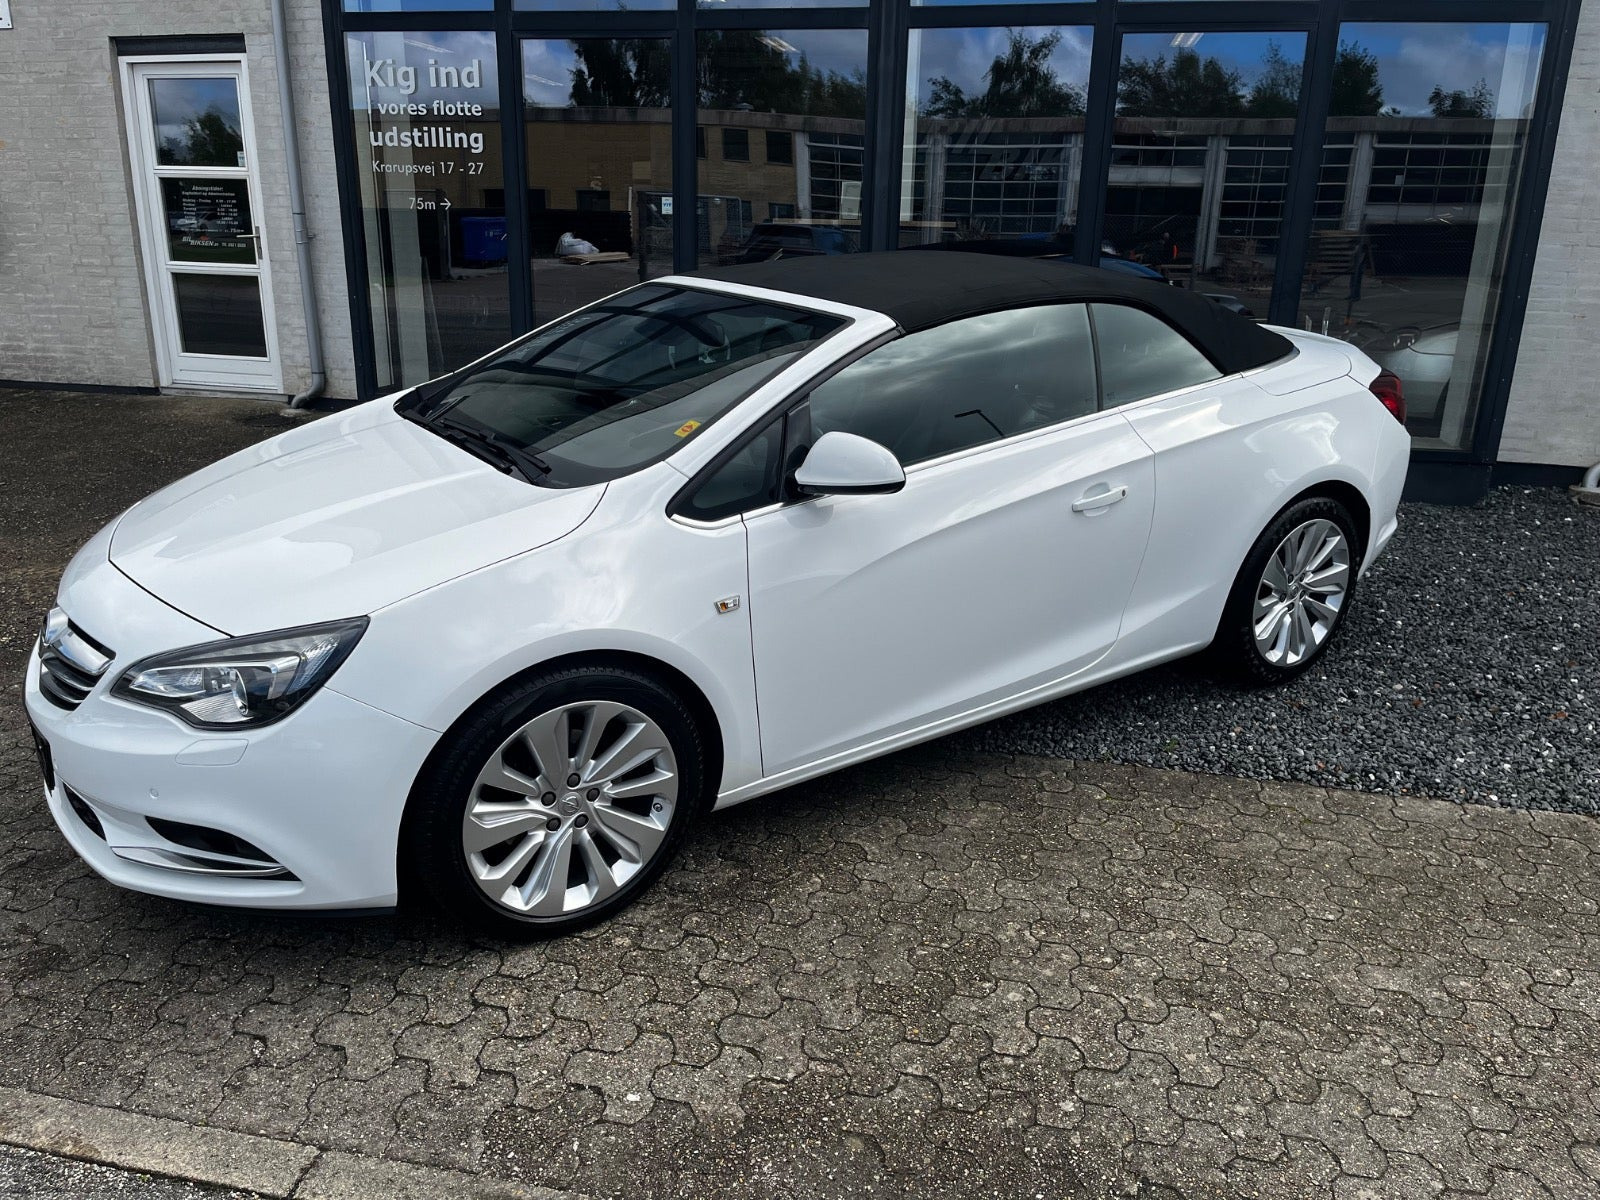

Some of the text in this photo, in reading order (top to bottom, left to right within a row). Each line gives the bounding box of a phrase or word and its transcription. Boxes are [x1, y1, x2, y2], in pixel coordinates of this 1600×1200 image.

[364, 59, 482, 95] Kig ind
[378, 103, 427, 116] vores
[433, 100, 482, 116] flotte
[370, 126, 484, 154] udstilling
[372, 160, 436, 177] Krarupsvej
[440, 161, 454, 175] 17
[468, 162, 484, 175] 27
[409, 198, 436, 210] 75m
